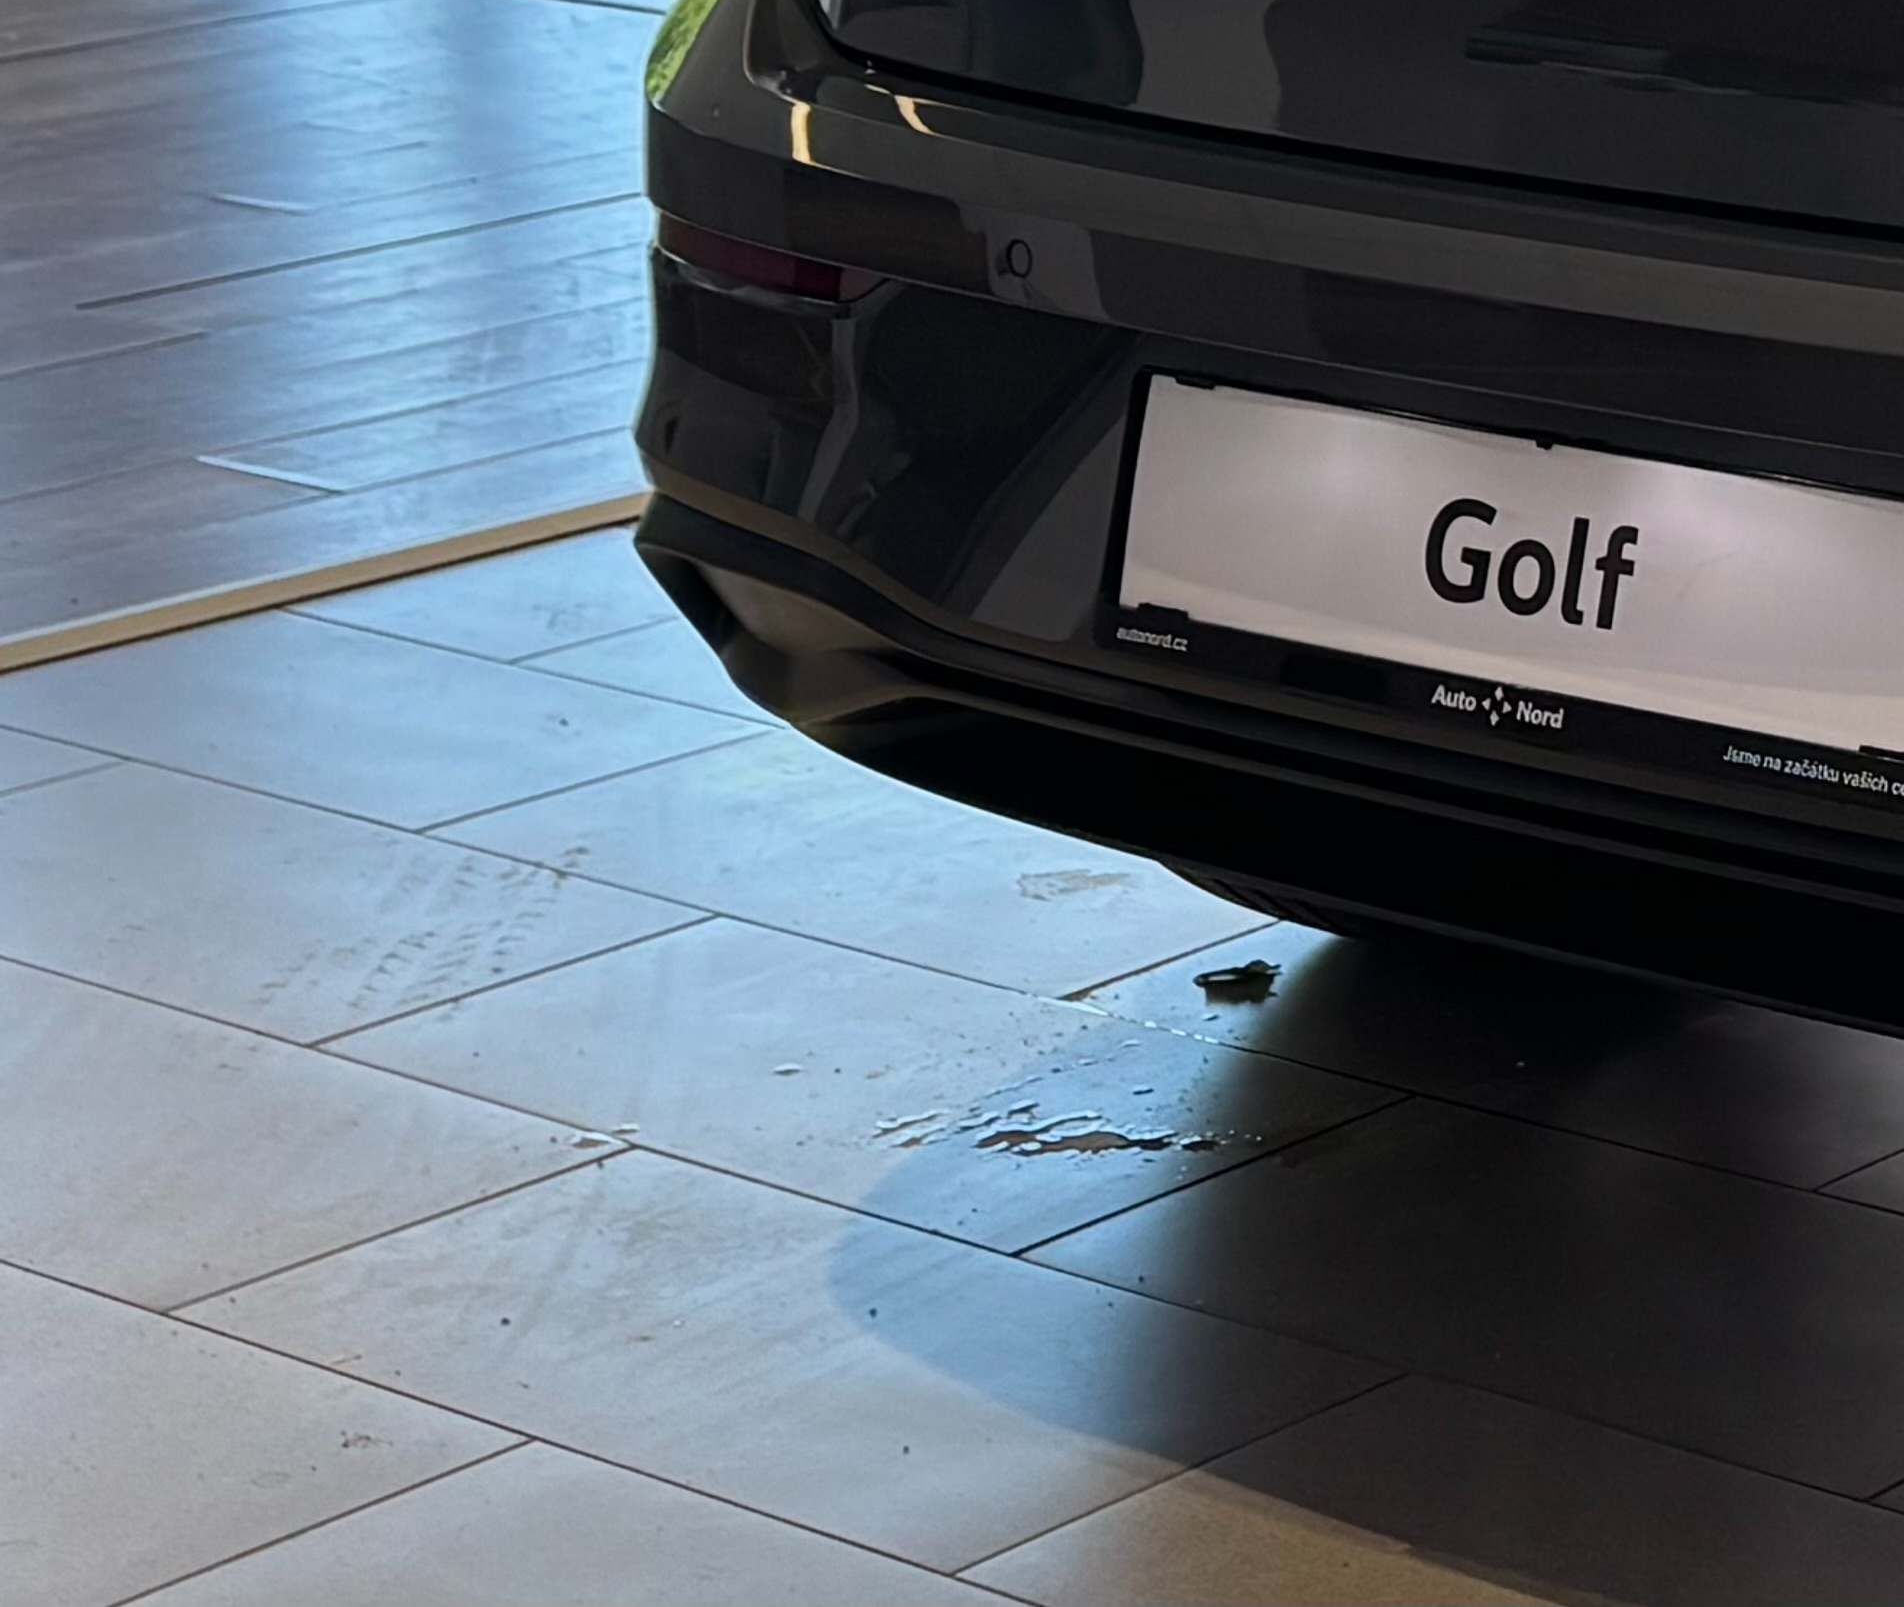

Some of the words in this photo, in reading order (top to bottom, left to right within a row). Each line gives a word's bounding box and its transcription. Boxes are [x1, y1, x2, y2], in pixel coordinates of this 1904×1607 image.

[1425, 498, 1639, 630] Golf
[1431, 684, 1477, 711] Auto
[1516, 700, 1564, 729] Nord
[1723, 746, 1761, 767] Jsme
[1763, 755, 1781, 771] na
